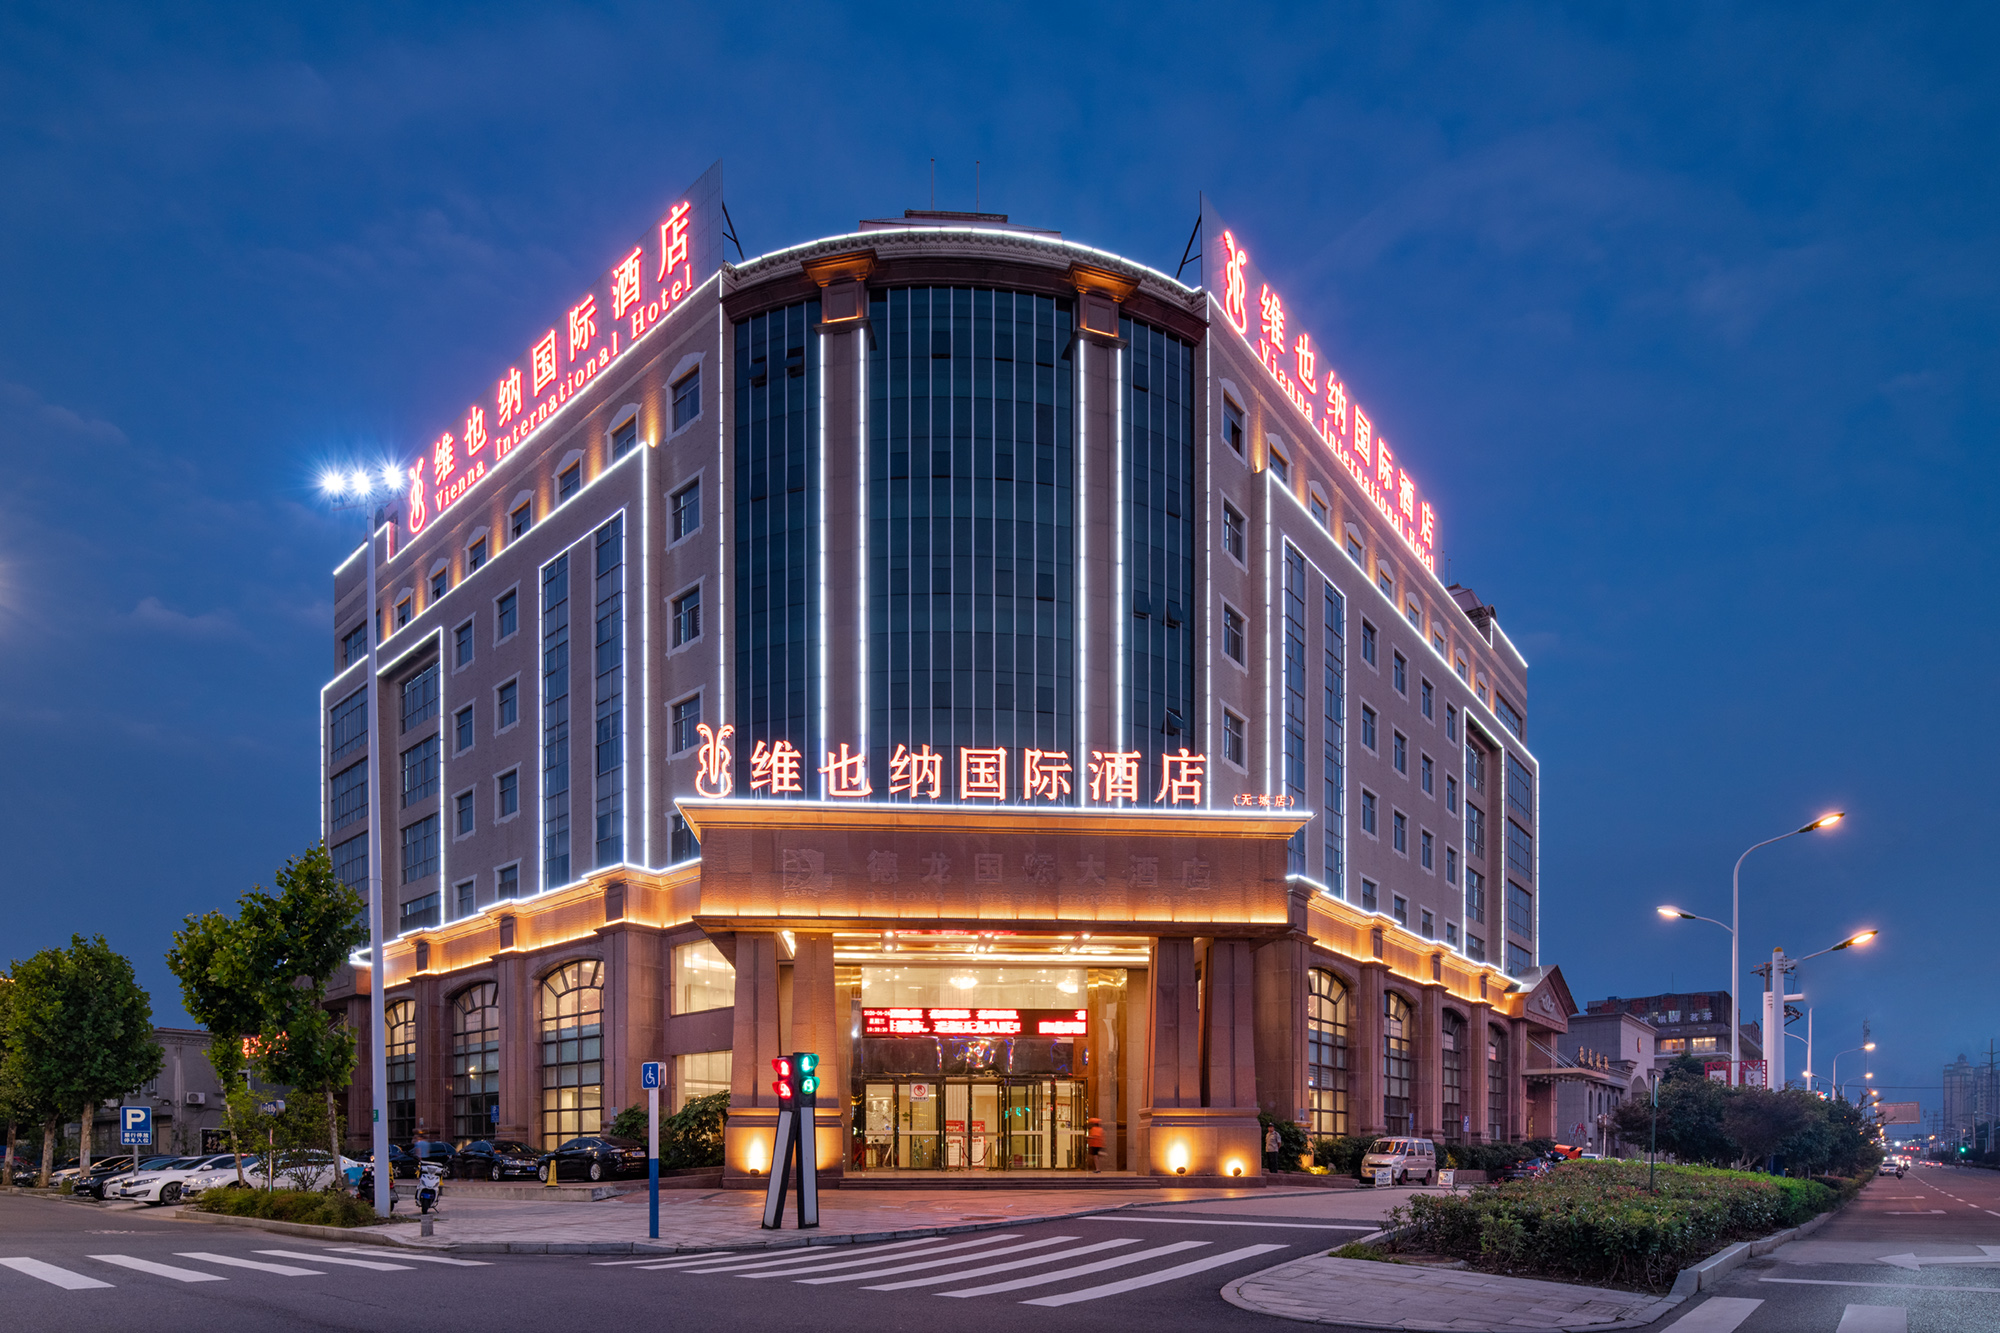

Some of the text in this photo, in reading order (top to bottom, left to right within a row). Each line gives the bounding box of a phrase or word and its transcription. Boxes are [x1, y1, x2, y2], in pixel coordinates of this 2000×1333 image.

[432, 200, 692, 487] 维也纳国际酒店
[434, 263, 693, 513] Vienna International Hotel
[1259, 283, 1436, 551] 维也纳国际酒店
[1259, 338, 1436, 575] Vienna International Hotel
[749, 739, 1208, 806] 维也纳国际酒店
[126, 1109, 146, 1130] P
